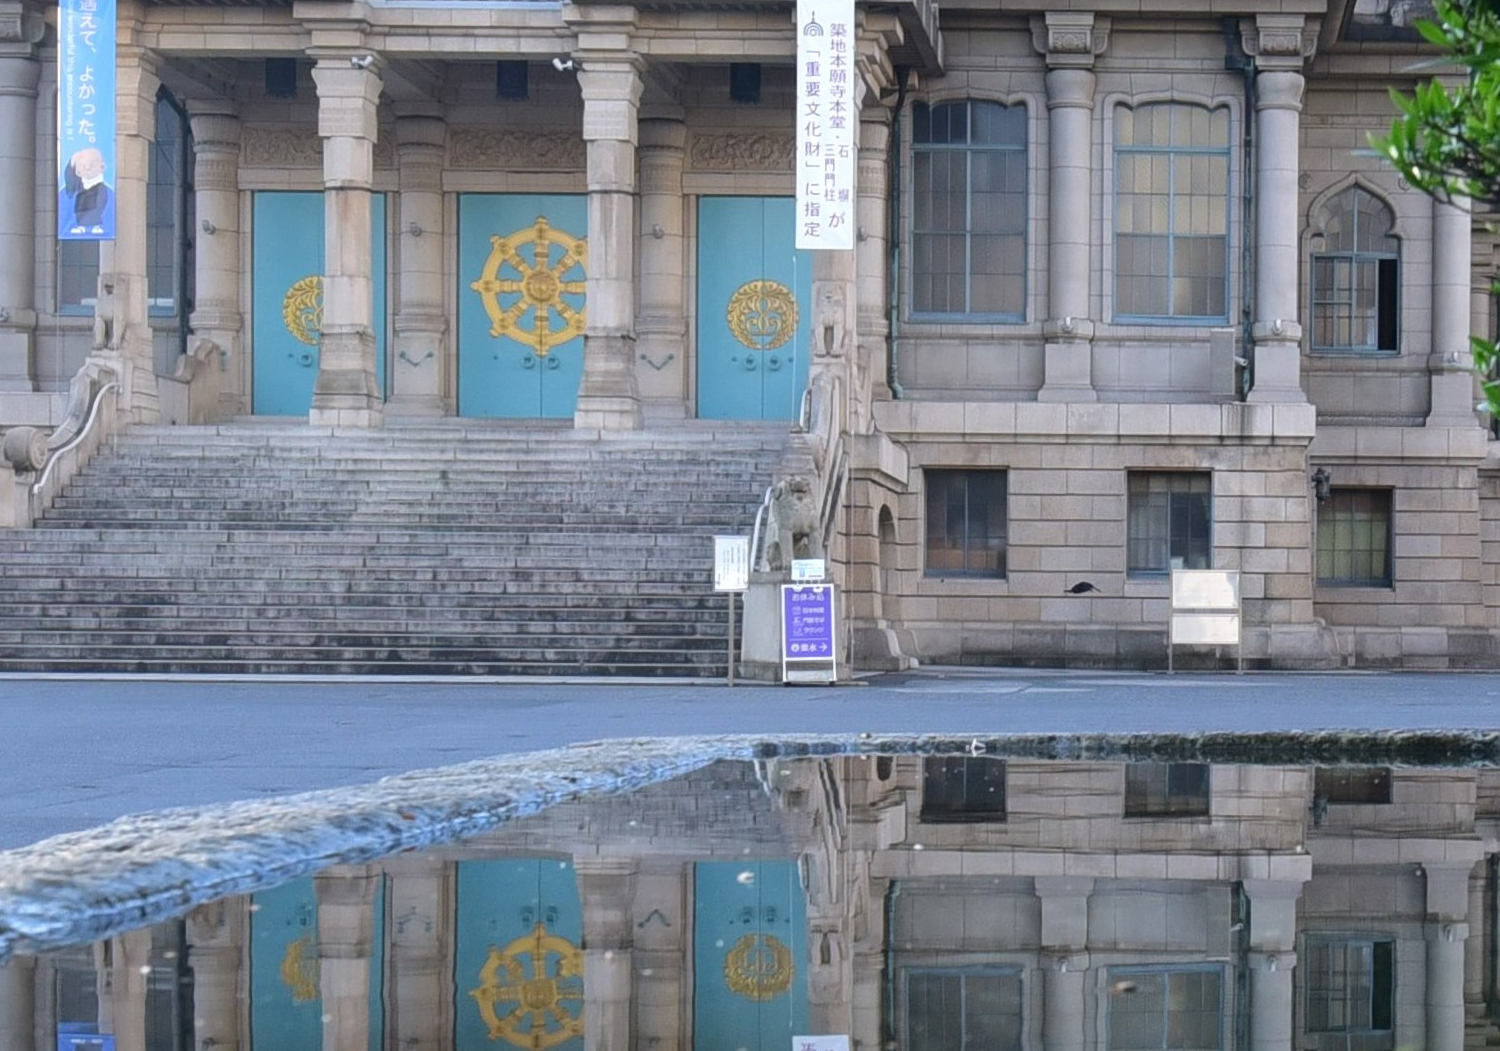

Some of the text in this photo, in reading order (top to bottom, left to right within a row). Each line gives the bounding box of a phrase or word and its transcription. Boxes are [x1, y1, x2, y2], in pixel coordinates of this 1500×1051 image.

[804, 50, 822, 238] 「重要文化財」に指定
